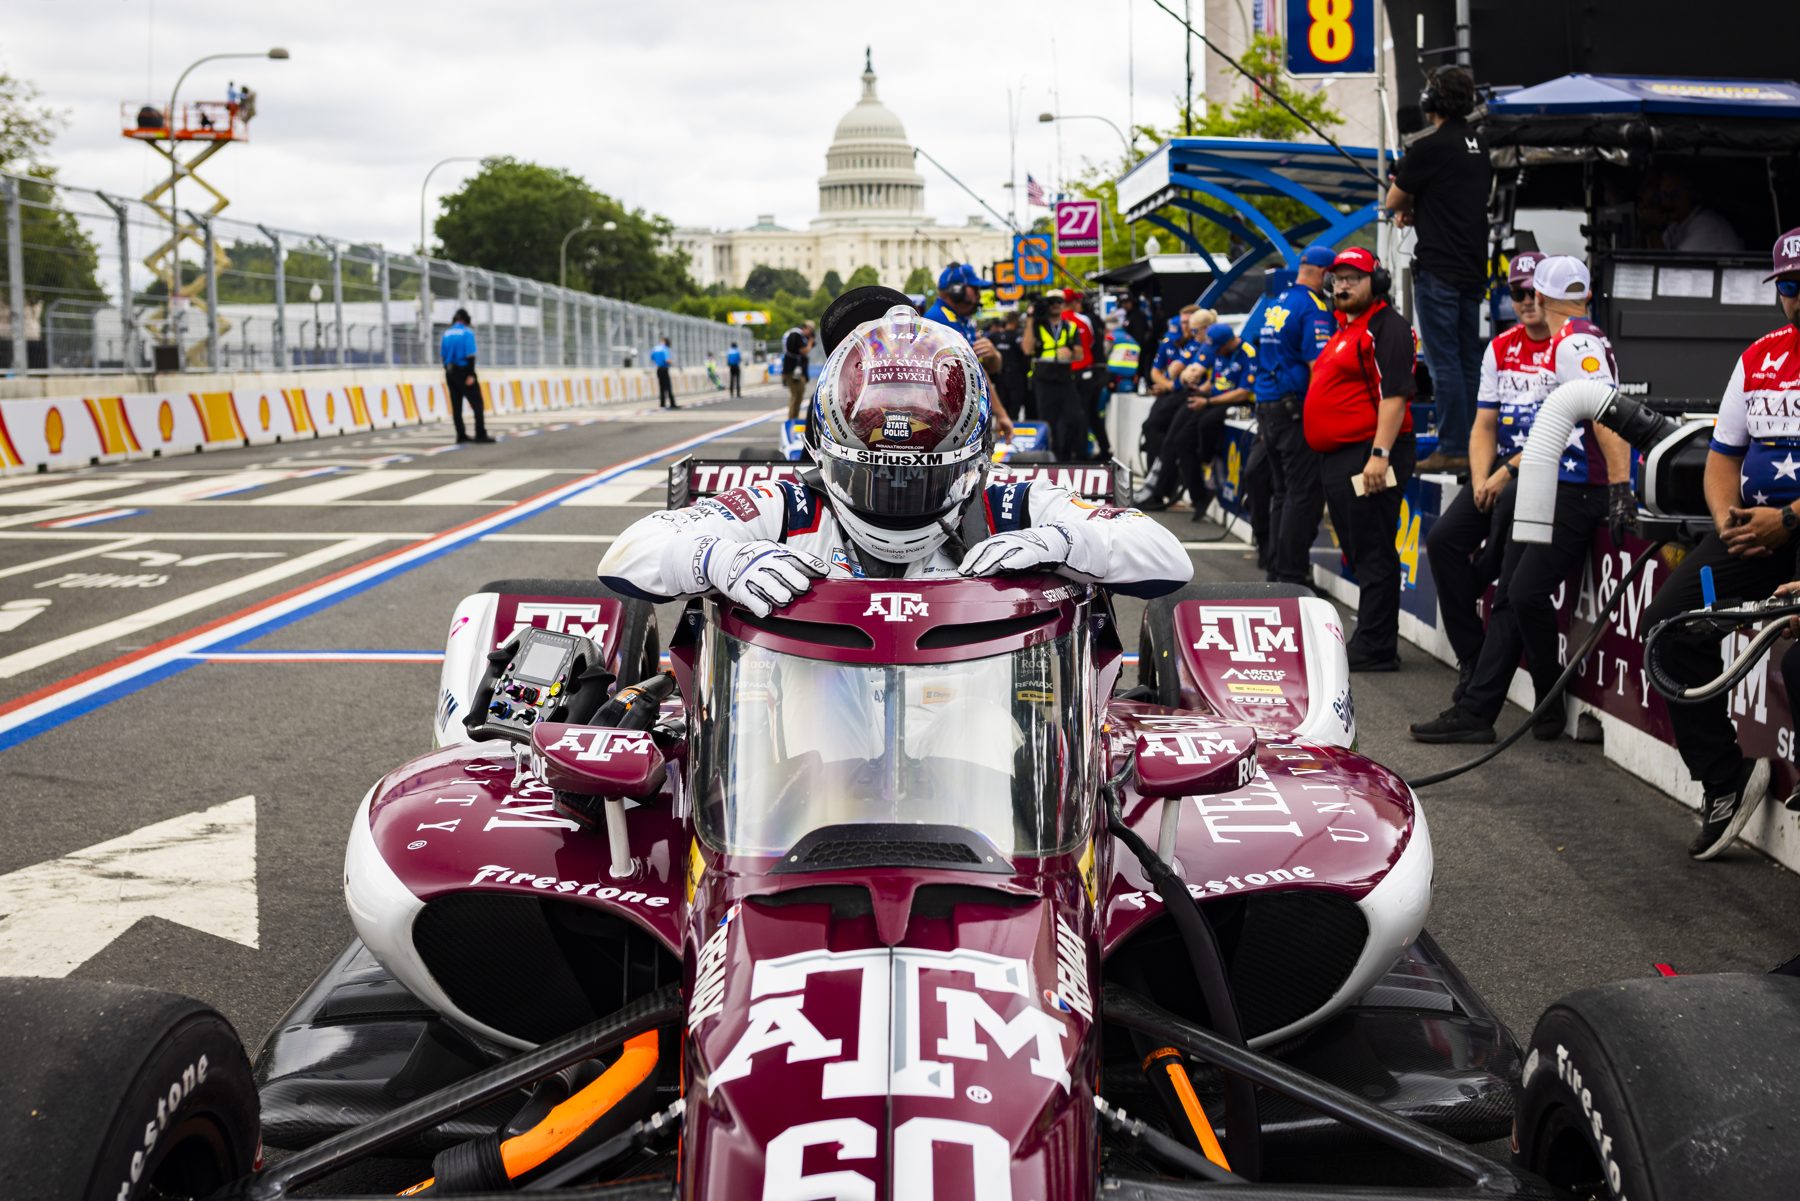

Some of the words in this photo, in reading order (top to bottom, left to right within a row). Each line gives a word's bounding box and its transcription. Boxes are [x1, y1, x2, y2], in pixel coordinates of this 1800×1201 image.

[1308, 0, 1354, 63] 8
[1059, 205, 1097, 235] 27
[871, 372, 894, 382] A&M
[897, 372, 934, 383] TEXAS
[1619, 382, 1648, 395] arged
[831, 409, 849, 440] GOOD
[886, 421, 908, 429] STATE
[883, 429, 909, 437] POLICE
[856, 450, 943, 466] SiriusXM
[1243, 669, 1287, 677] ARCTIC
[1249, 674, 1285, 682] WOLF
[469, 864, 670, 908] Firestone
[1118, 864, 1315, 910] Fiestone
[1556, 1043, 1628, 1201] Firesto
